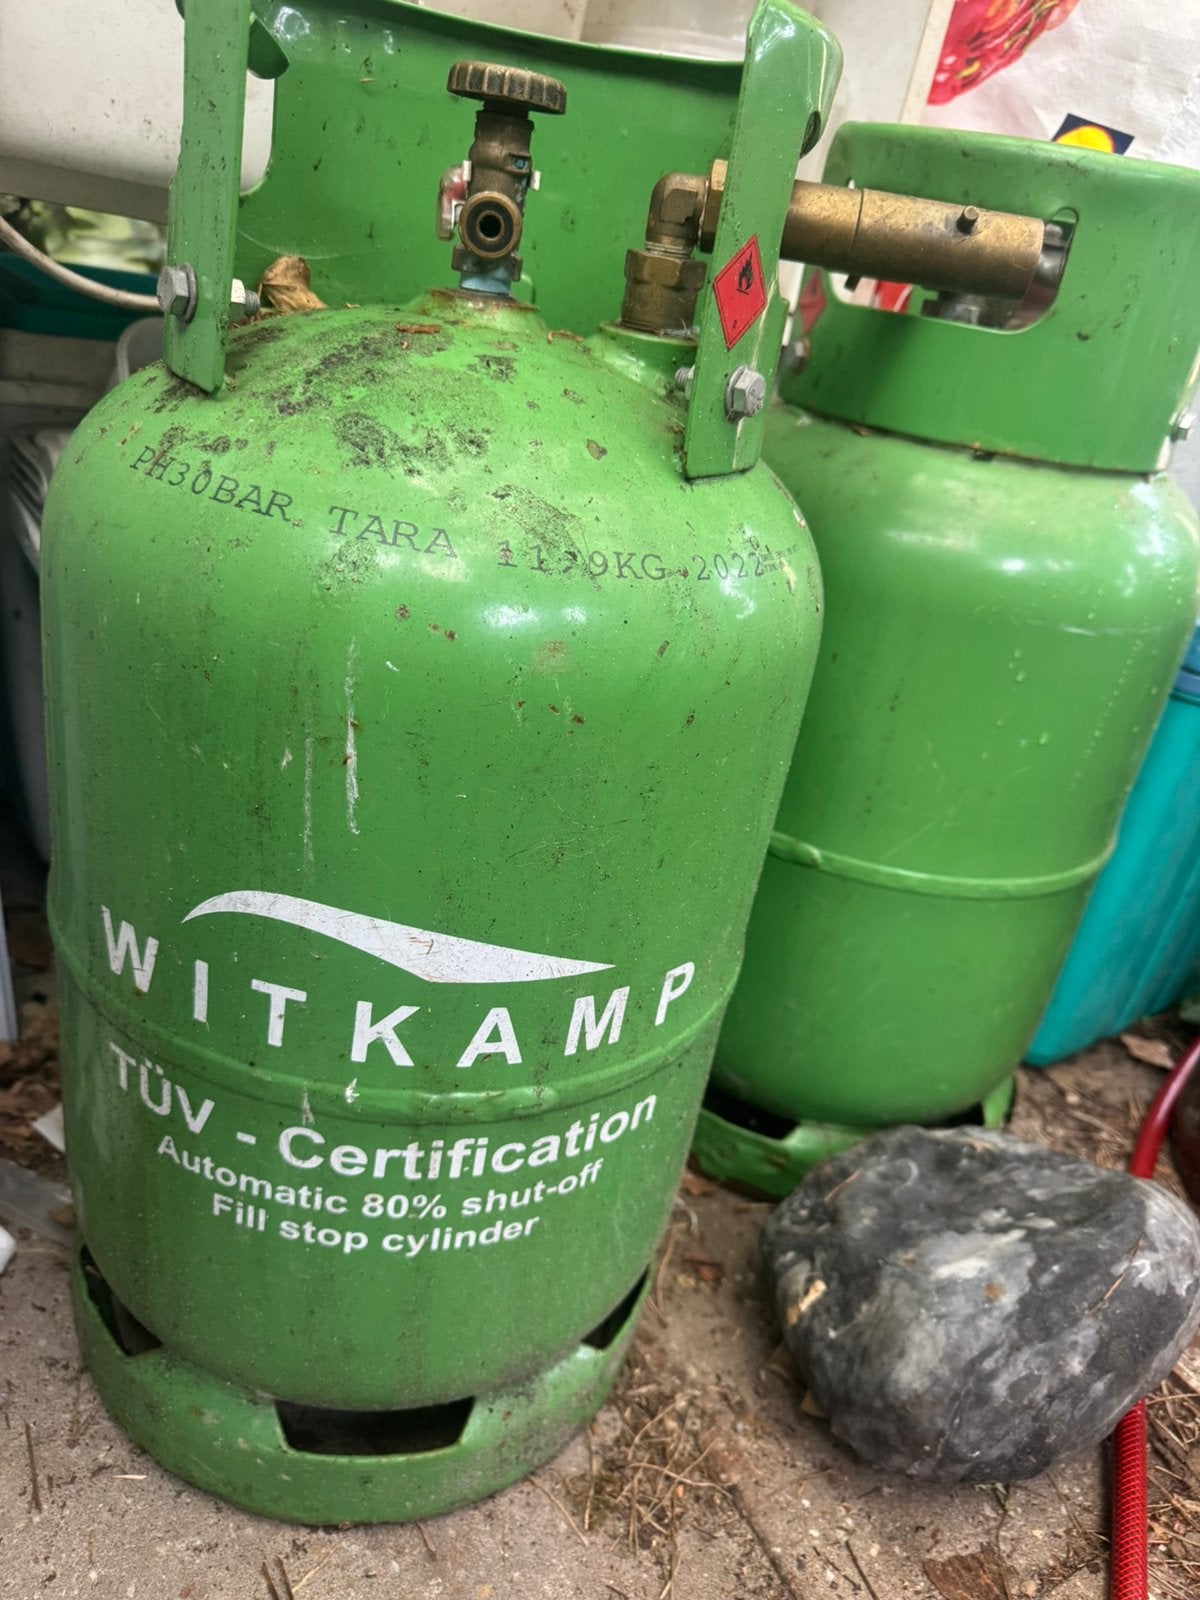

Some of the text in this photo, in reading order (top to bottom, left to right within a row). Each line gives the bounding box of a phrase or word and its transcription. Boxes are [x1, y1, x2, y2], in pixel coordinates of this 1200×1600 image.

[129, 445, 291, 522] PH30BAR
[328, 505, 458, 559] TARA
[692, 552, 764, 582] 2022
[101, 904, 696, 1068] WITKAMP
[109, 1042, 215, 1134] TÜV
[278, 1094, 657, 1180] Certification
[157, 1135, 604, 1219] Automatic 80% shut-off
[212, 1193, 540, 1257] Fill stop cylinder
